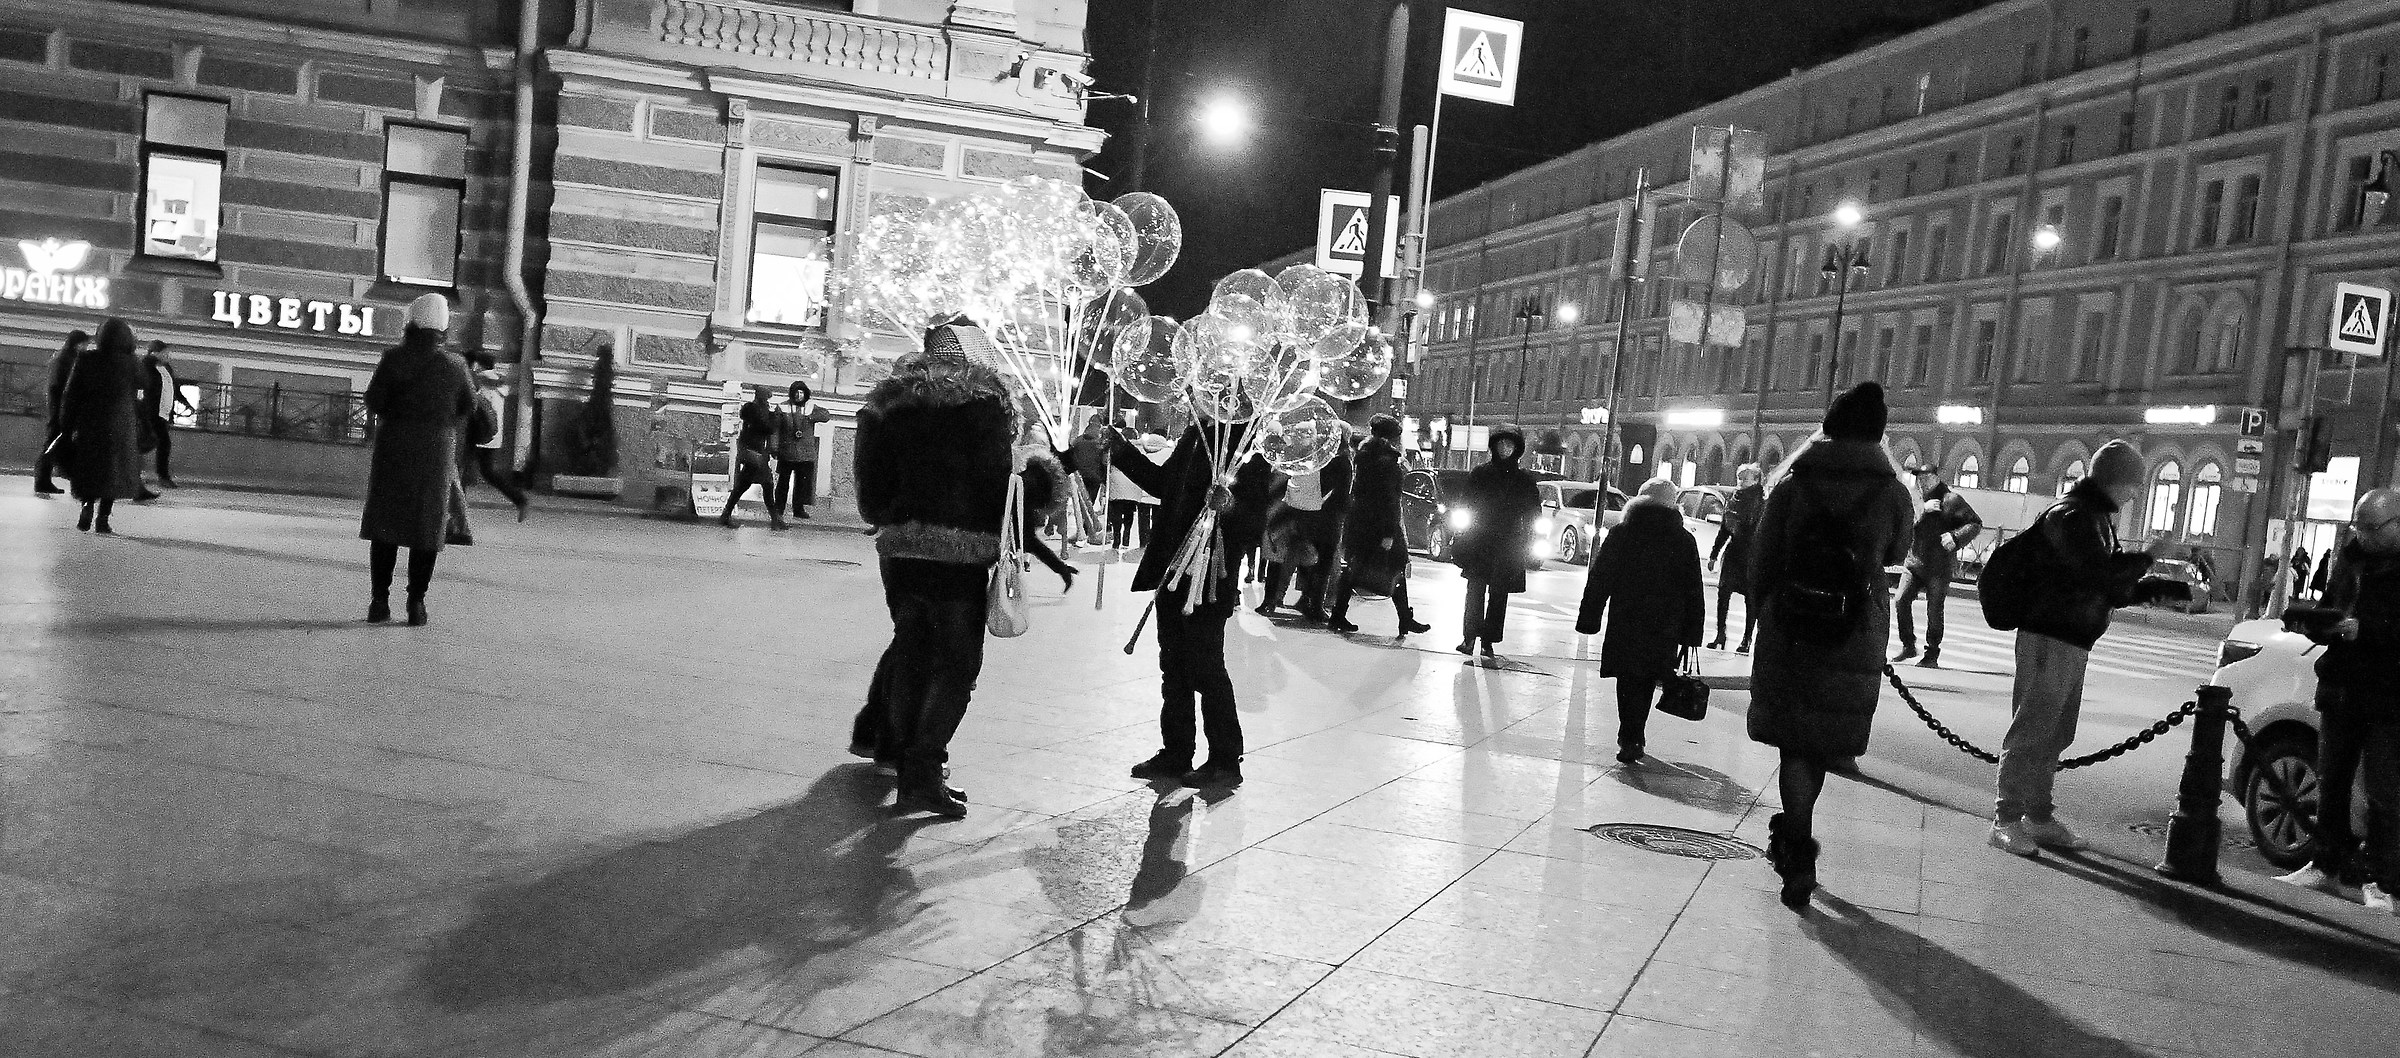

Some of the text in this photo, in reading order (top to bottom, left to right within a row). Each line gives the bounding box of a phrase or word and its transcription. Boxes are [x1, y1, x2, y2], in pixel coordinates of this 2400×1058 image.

[0, 265, 110, 310] РАНЖ
[211, 290, 374, 336] ЦВЕТЫ
[2248, 411, 2262, 433] P
[697, 495, 727, 503] НОЧНО
